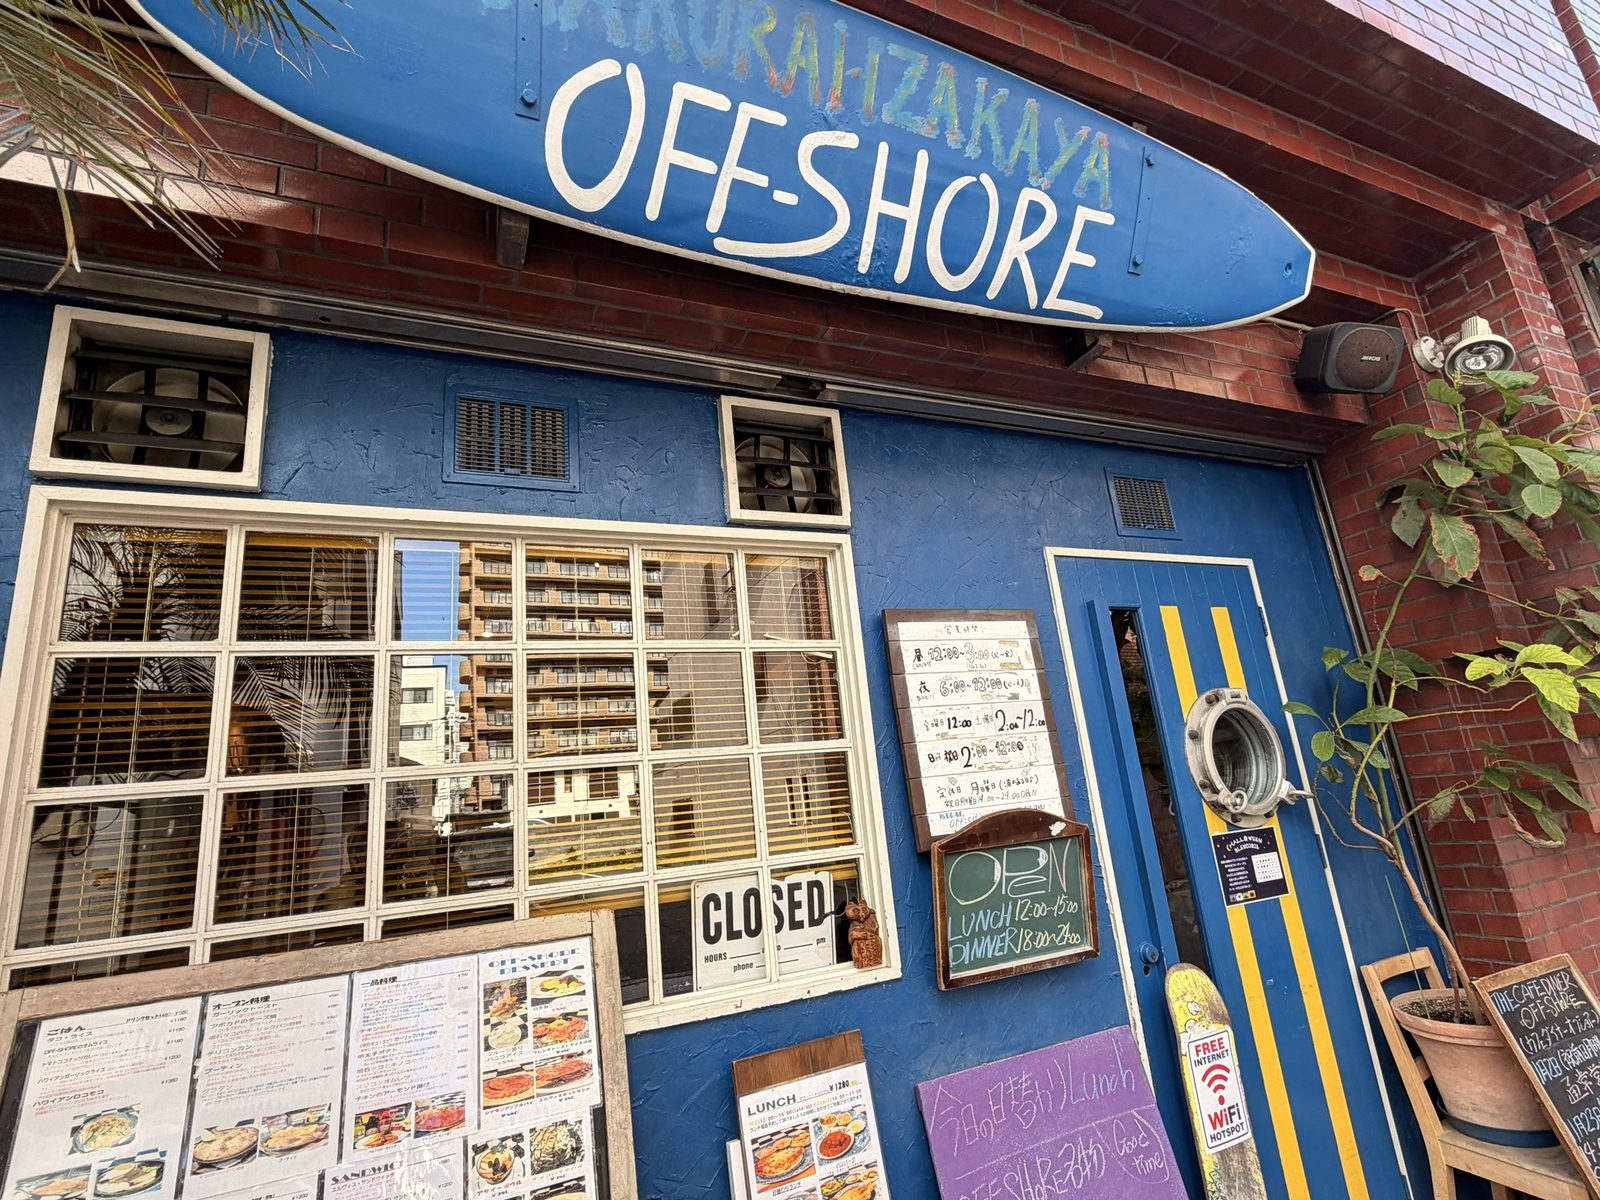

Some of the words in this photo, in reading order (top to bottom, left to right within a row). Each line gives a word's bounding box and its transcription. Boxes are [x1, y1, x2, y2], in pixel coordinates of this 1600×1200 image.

[544, 58, 1115, 320] OFF-SHORE
[947, 716, 972, 730] 12:00
[949, 839, 1071, 905] OPEN
[702, 879, 825, 945] CLOSED
[948, 901, 1012, 942] LUNCH
[704, 952, 727, 963] HOURS
[816, 937, 826, 946] pm
[950, 927, 1020, 967] DINNER
[733, 962, 753, 973] phone
[360, 976, 398, 987] 一品料理
[1490, 991, 1520, 1014] THE
[1512, 980, 1547, 1003] CAFE
[1540, 971, 1578, 996] DINER
[212, 995, 270, 1010] オープン料理
[212, 1003, 278, 1018] ガーリックトースト
[1520, 992, 1587, 1029] OFF-SHORE
[47, 1025, 86, 1036] ごはん
[1194, 1049, 1230, 1067] INTERNET
[1195, 1037, 1225, 1057] FREE
[1067, 1038, 1135, 1105] Lunch
[33, 1089, 105, 1107] ハワイアンロコモコ
[747, 1094, 796, 1116] LUNCH
[829, 1080, 850, 1092] ¥1280
[1208, 1103, 1241, 1131] WiFi
[1210, 1121, 1245, 1143] HOTSPOT
[1132, 1151, 1164, 1177] time
